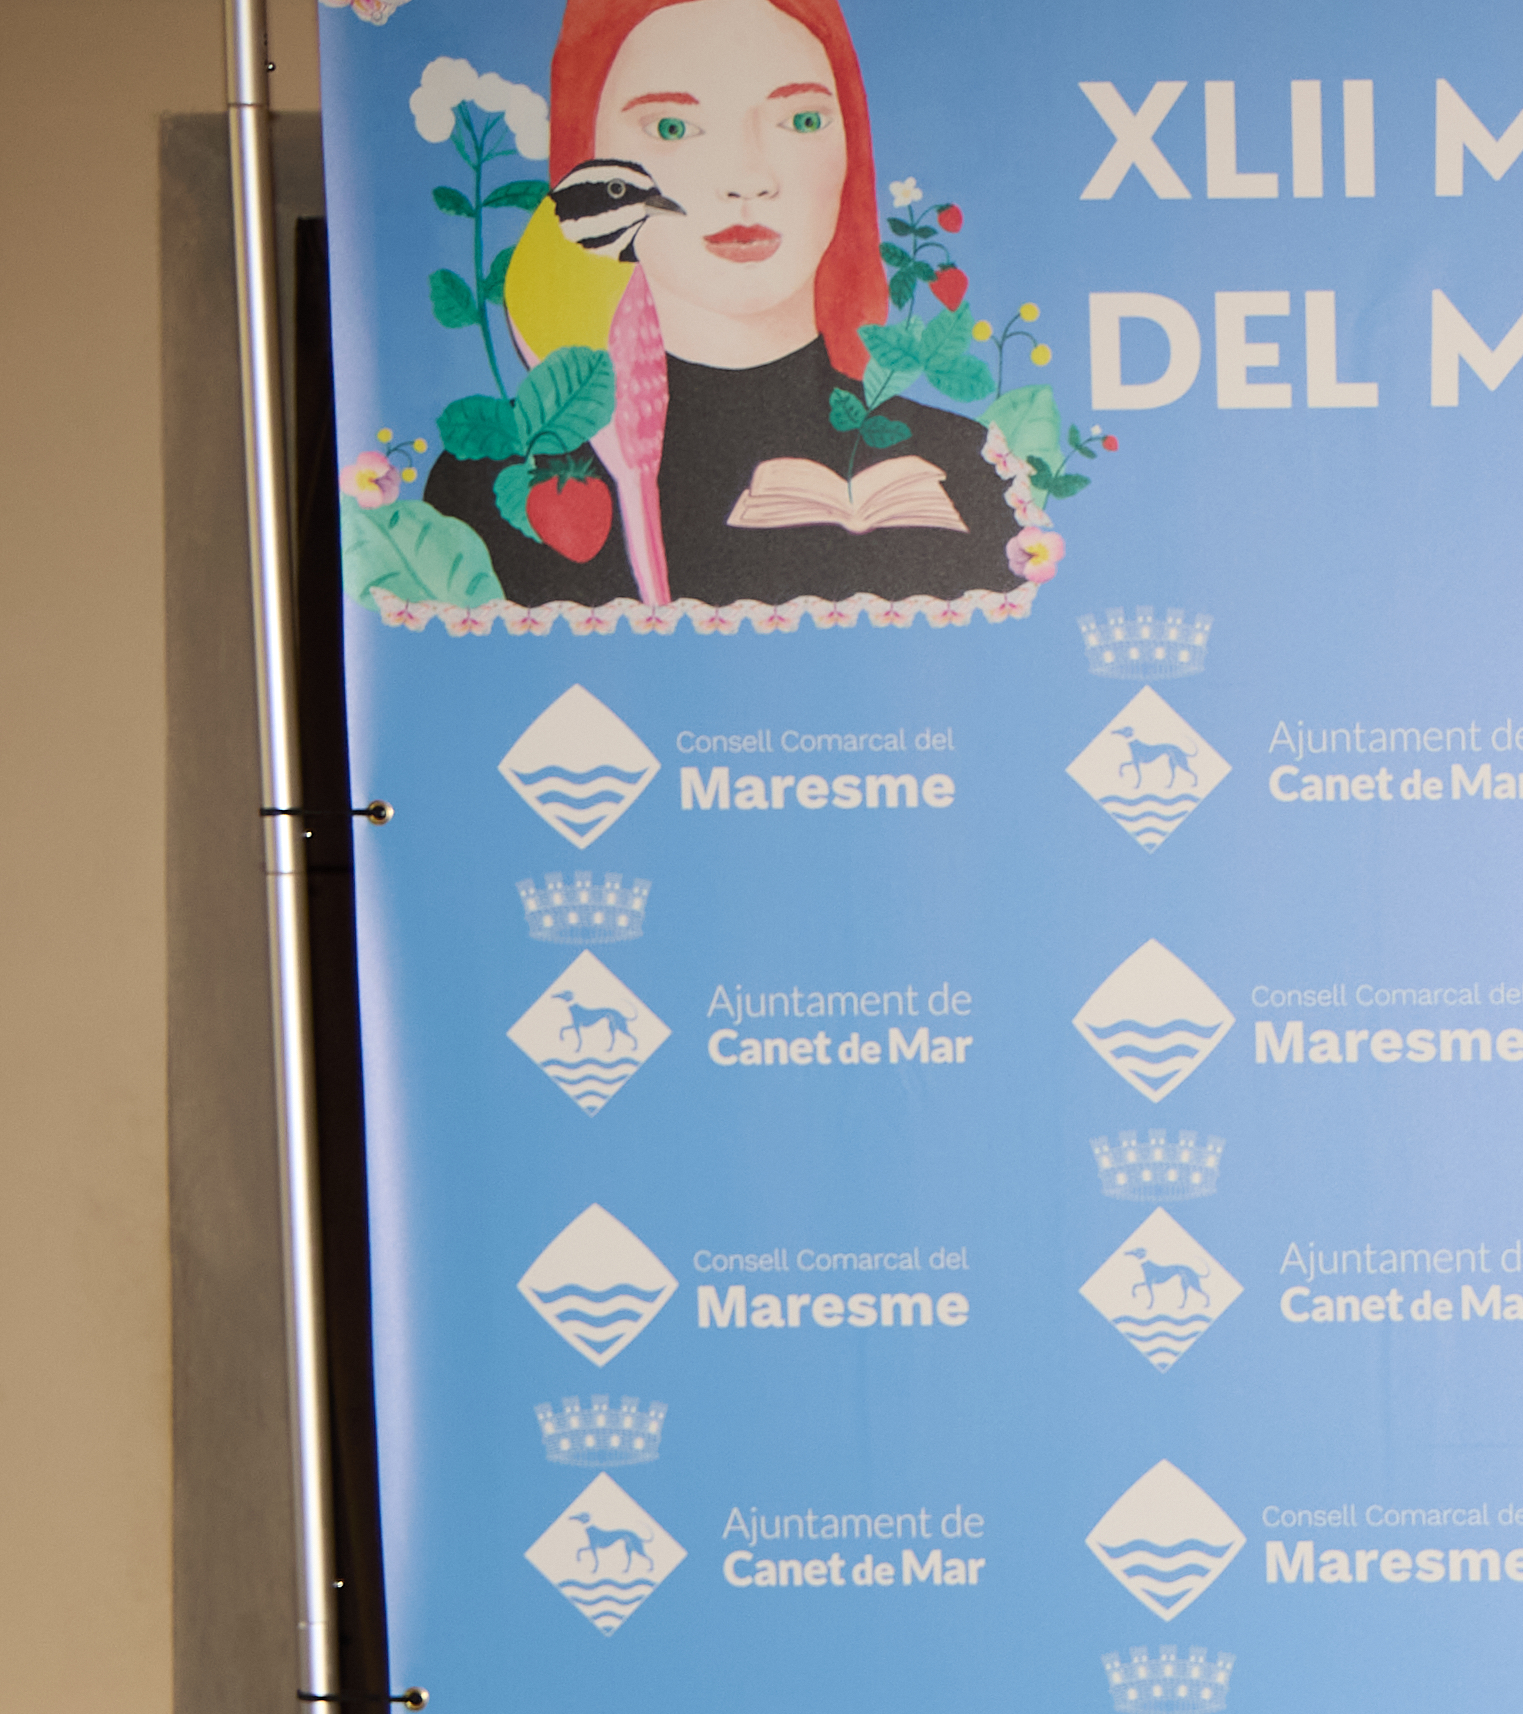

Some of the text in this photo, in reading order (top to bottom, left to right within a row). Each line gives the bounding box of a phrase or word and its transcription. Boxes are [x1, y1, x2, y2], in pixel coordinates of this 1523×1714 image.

[1078, 80, 1377, 200] XLII
[1088, 289, 1379, 410] DEL
[677, 729, 953, 751] Consell Comarcal del
[1269, 720, 1480, 760] Ajuntament
[680, 766, 955, 810] Maresme
[1269, 764, 1393, 802] Canet
[1400, 768, 1443, 801] de
[707, 982, 972, 1025] Ajuntament de
[708, 1027, 974, 1066] Canet de Mar
[1280, 1242, 1489, 1282] Ajuntament
[697, 1285, 970, 1328] Maresme
[1280, 1285, 1404, 1323] Canet
[1410, 1290, 1453, 1321] de
[722, 1505, 984, 1546] Ajuntament de
[723, 1549, 986, 1587] Canet de Mar
